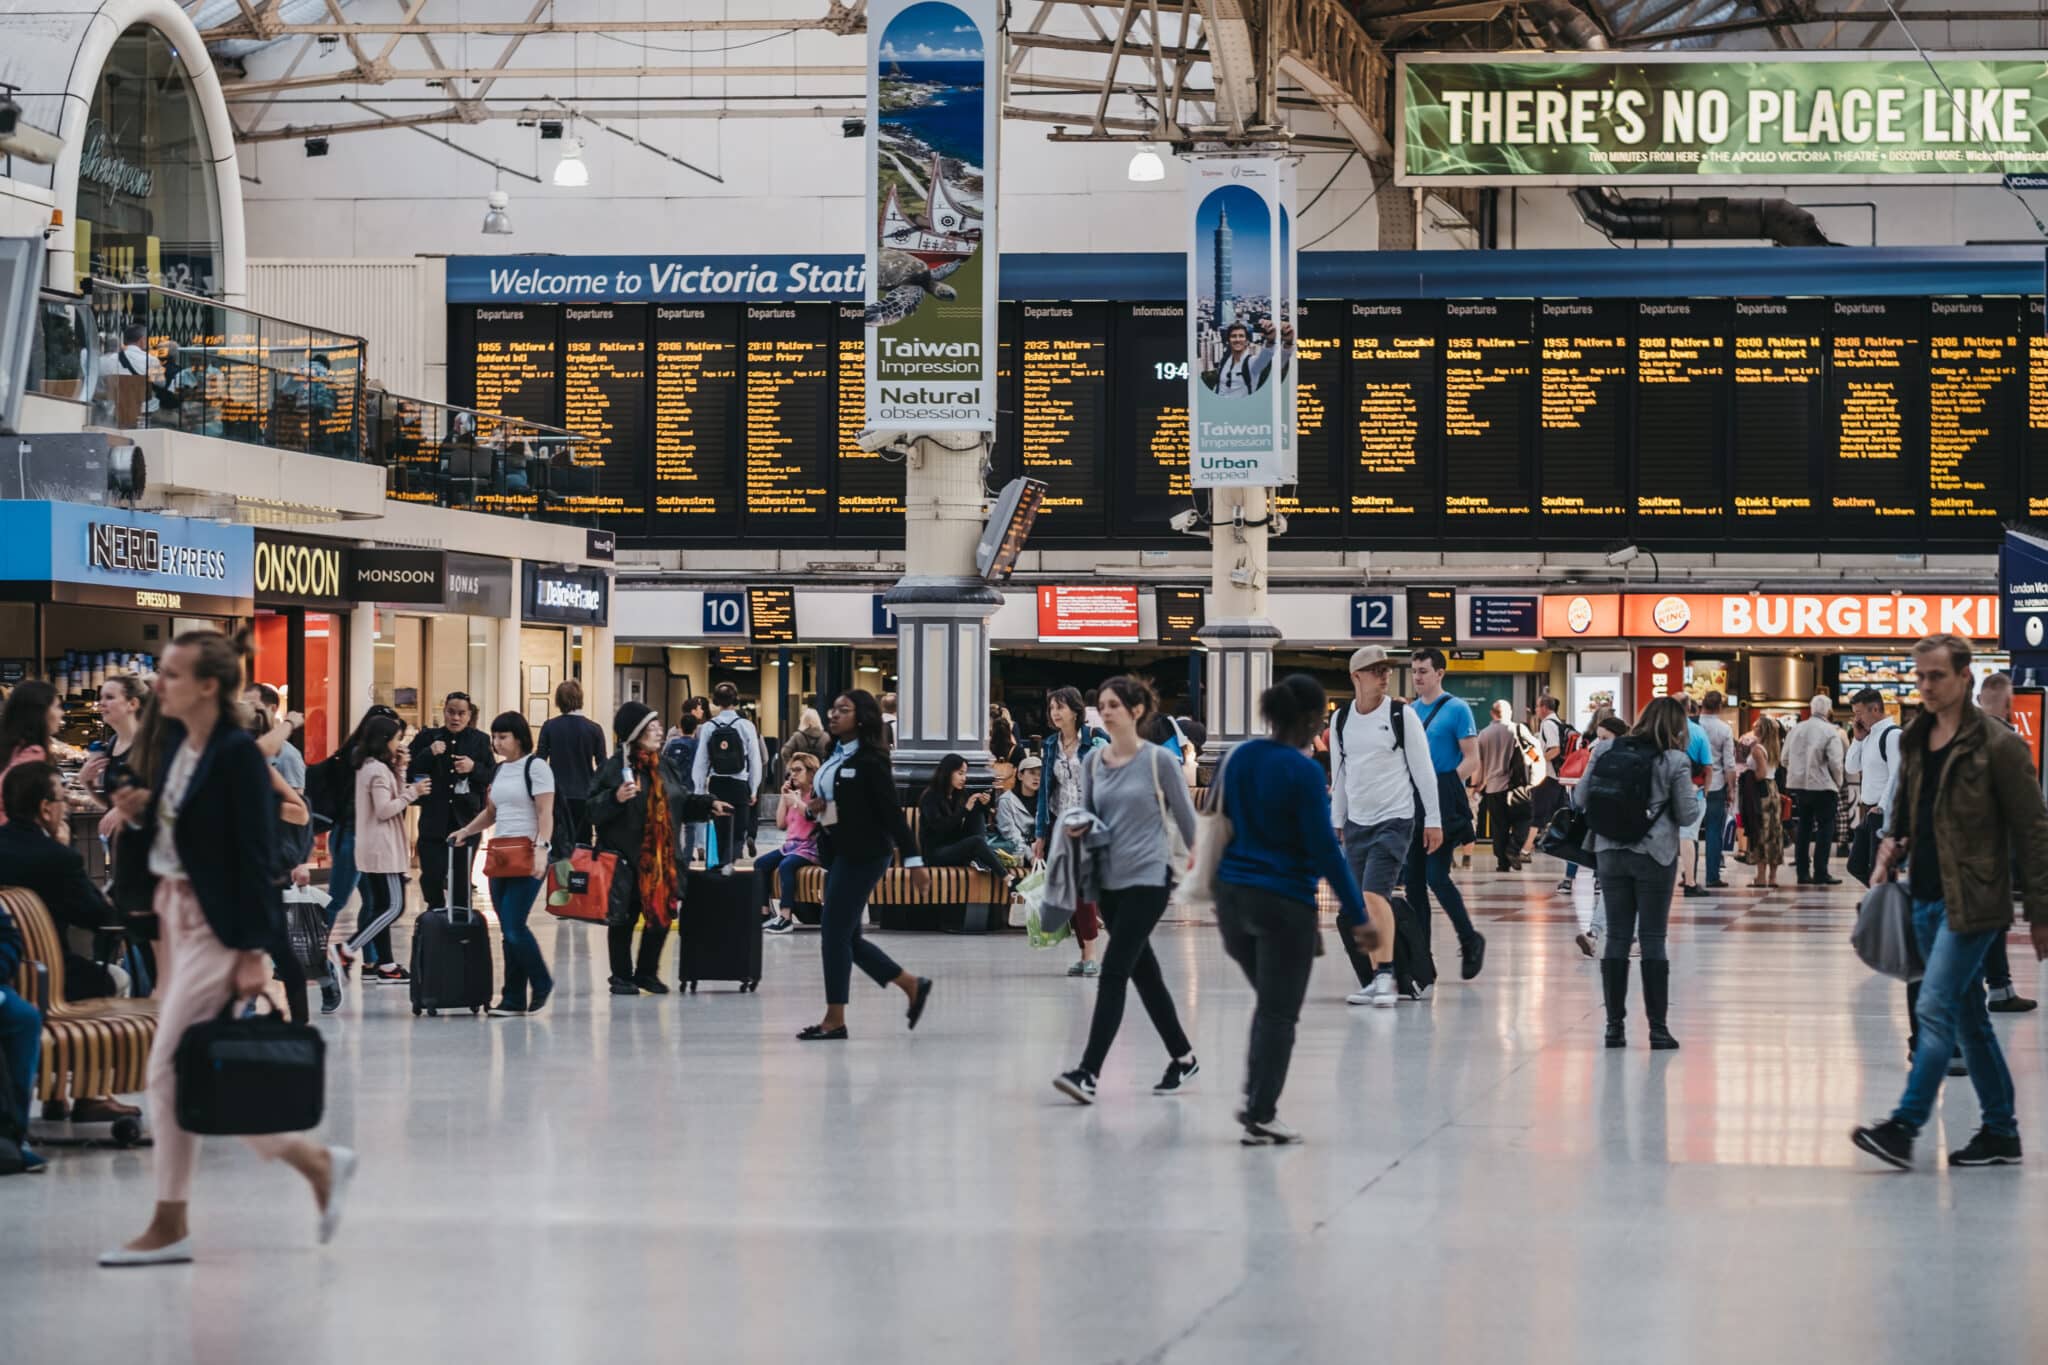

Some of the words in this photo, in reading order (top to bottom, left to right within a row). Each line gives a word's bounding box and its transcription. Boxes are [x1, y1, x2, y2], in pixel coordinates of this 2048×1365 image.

[1441, 89, 1646, 145] THERE'S
[1663, 88, 1729, 144] NO
[1748, 88, 1905, 144] PLACE
[1923, 88, 2032, 143] LIKE
[1589, 152, 1607, 162] TWO
[1609, 152, 1647, 162] MINUTES
[1650, 152, 1674, 162] FROM
[1676, 152, 1700, 162] HERE
[1710, 152, 1729, 162] THE
[1732, 152, 1776, 162] APOLLO
[1779, 152, 1831, 162] VICTORIA
[1834, 151, 1879, 162] THEATRE
[1889, 151, 1933, 161] DISCOVER
[1935, 151, 1965, 161] MORE:
[489, 268, 608, 295] Welcome
[616, 271, 642, 294] to
[650, 262, 778, 294] Victoria
[786, 262, 865, 293] Stati
[566, 308, 613, 320] Departures
[658, 308, 704, 320] Departures
[748, 308, 795, 320] Departures
[1025, 307, 1073, 319] Departures
[1132, 306, 1184, 317] Information
[1353, 305, 1402, 317] Departures
[1448, 304, 1496, 316] Departures
[1543, 304, 1592, 316] Departures
[1640, 303, 1690, 316] Departures
[1737, 303, 1787, 315] Departures
[1835, 303, 1885, 315] Departures
[1932, 303, 1983, 314] Departures
[477, 309, 524, 321] Departures
[509, 342, 546, 352] Platform
[547, 342, 555, 352] 4
[599, 342, 636, 352] Platform
[637, 342, 645, 352] 3
[685, 341, 723, 351] Platform
[776, 341, 814, 351] Platform
[1053, 340, 1091, 350] Platform
[1393, 338, 1435, 348] Cancelled
[1476, 338, 1516, 348] Platform
[1573, 337, 1613, 348] Platform
[1670, 337, 1711, 348] Platform
[1767, 337, 1808, 348] Platform
[1864, 337, 1904, 347] Platform
[1963, 336, 2004, 347] Platform
[880, 338, 980, 357] Taiwan
[476, 353, 511, 363] Ashford
[565, 353, 608, 364] Orpington
[656, 353, 703, 362] Gravesend
[747, 352, 774, 362] Dover
[775, 352, 804, 362] Priory
[1023, 351, 1060, 361] Ashford
[1351, 349, 1374, 359] East
[1375, 349, 1420, 359] Grinstead
[1446, 350, 1482, 360] Dorking
[1541, 349, 1582, 360] Brighton
[1638, 349, 1668, 360] Epsom
[1669, 349, 1699, 360] Downs
[1735, 348, 1771, 359] Gatwick
[1772, 348, 1807, 359] Airport
[1858, 348, 1897, 359] Croydon
[881, 359, 979, 375] Impression
[1154, 361, 1189, 379] 19:4
[881, 387, 980, 404] Natural
[880, 406, 980, 420] obsession
[1200, 422, 1271, 436] Taiwan
[1200, 437, 1271, 449] Impression
[1201, 457, 1258, 469] Urban
[1201, 469, 1249, 480] appeal
[656, 496, 715, 505] Southeastern
[747, 496, 806, 505] Southeastern
[838, 496, 898, 505] Southeastern
[1351, 496, 1394, 505] Southern
[1445, 496, 1489, 506] Southern
[1541, 496, 1585, 506] Southern
[1637, 496, 1681, 507] Southern
[1734, 496, 1770, 507] Gatwick
[1771, 496, 1811, 507] Express
[1832, 497, 1876, 507] Southern
[1930, 497, 1974, 508] Southern
[89, 522, 161, 572] NERO
[160, 544, 226, 581] EXPRESS
[255, 542, 340, 597] ONSOON
[358, 569, 435, 584] MONSOON
[2009, 582, 2034, 594] London
[137, 591, 167, 608] ESPRESSO
[168, 594, 181, 609] BAR
[706, 600, 740, 626] 10
[1356, 601, 1388, 628] 12
[1722, 597, 1929, 636] BURGER
[1940, 597, 2000, 636] KI
